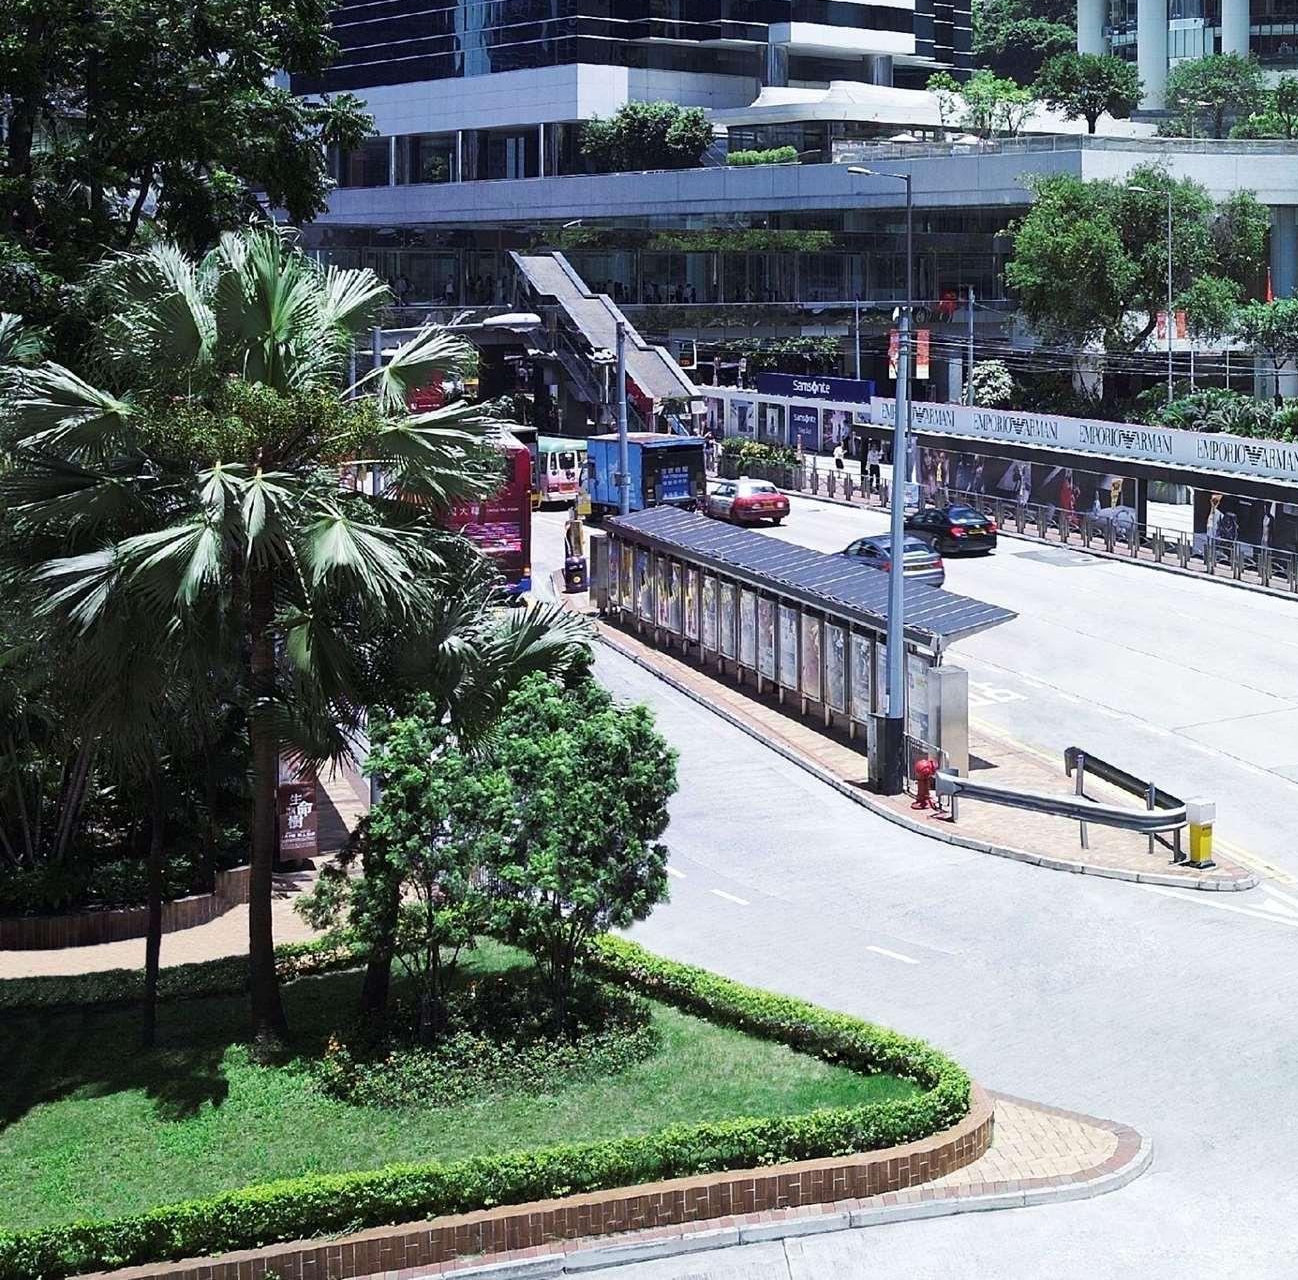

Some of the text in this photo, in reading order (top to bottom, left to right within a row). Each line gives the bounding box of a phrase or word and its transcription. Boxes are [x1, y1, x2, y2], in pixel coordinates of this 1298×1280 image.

[924, 407, 955, 427] ARMANI
[973, 413, 1058, 440] EMPORIO ARMANI
[1079, 425, 1173, 455] EMPORIO ARMANI
[1197, 439, 1246, 466] EMPORIO
